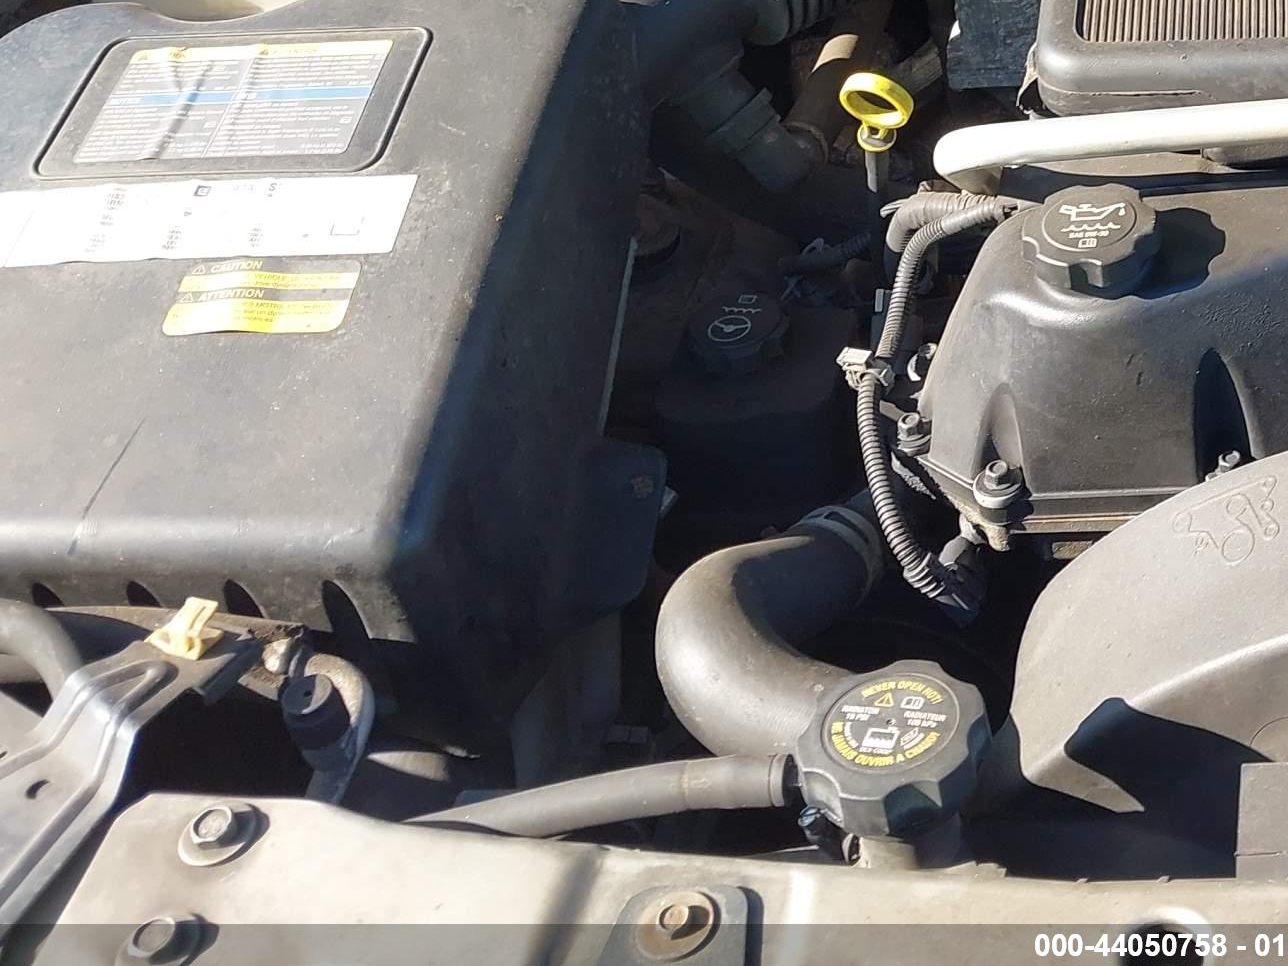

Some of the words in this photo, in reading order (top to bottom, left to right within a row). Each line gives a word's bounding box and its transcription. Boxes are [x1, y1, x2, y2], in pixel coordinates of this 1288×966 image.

[210, 260, 263, 273] CAUTION
[199, 289, 265, 301] ATTENTION
[862, 681, 896, 698] NEVER
[897, 681, 926, 692] OPEN
[831, 734, 858, 760] JAMAIS
